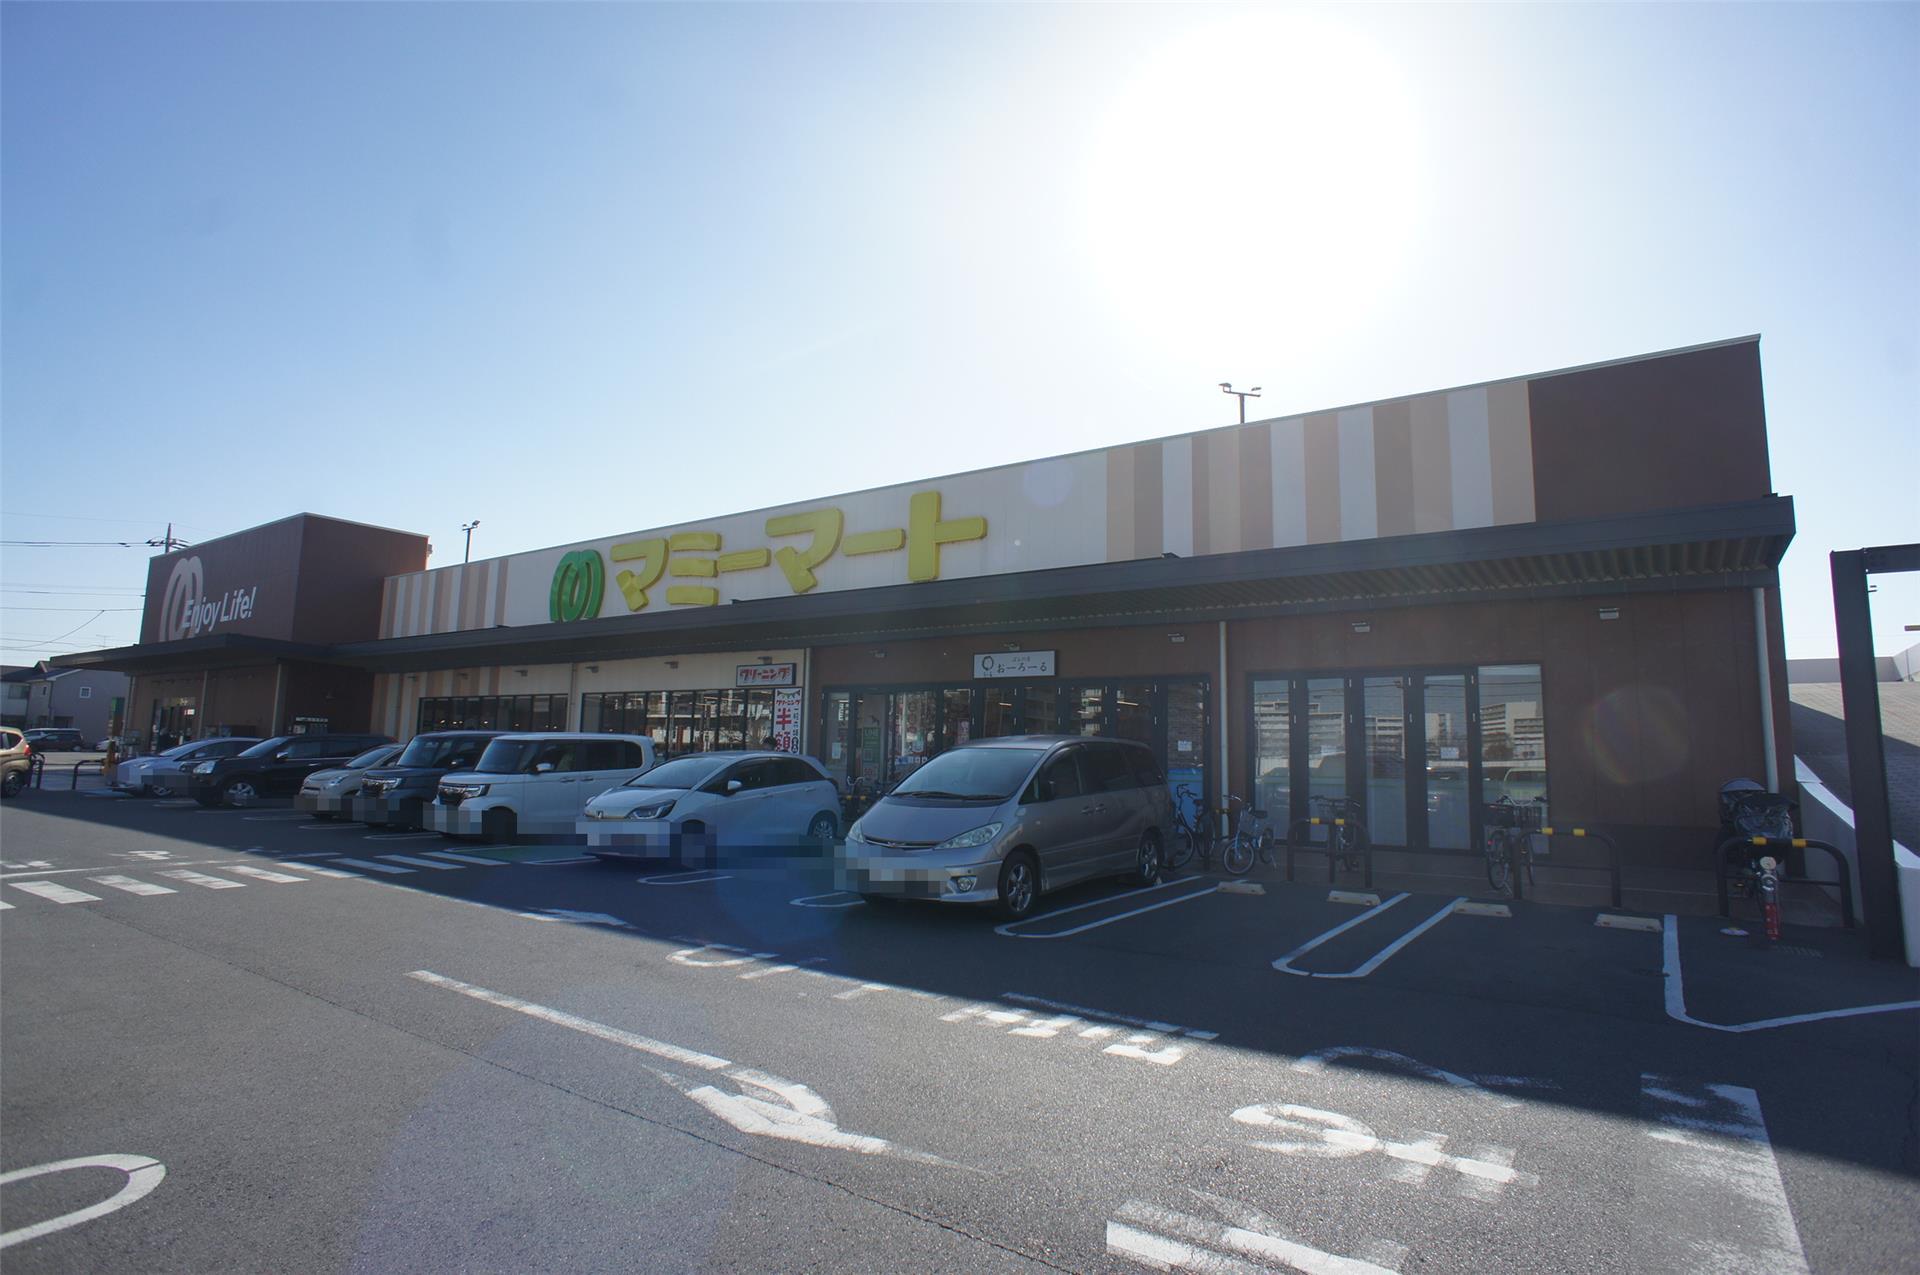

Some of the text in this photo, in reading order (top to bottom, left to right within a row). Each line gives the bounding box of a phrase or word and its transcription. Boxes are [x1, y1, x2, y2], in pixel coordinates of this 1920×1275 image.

[610, 490, 987, 611] マミーマート
[181, 587, 256, 634] Enjoy Life!
[739, 667, 790, 681] クリーニング
[775, 707, 792, 752] 半額
